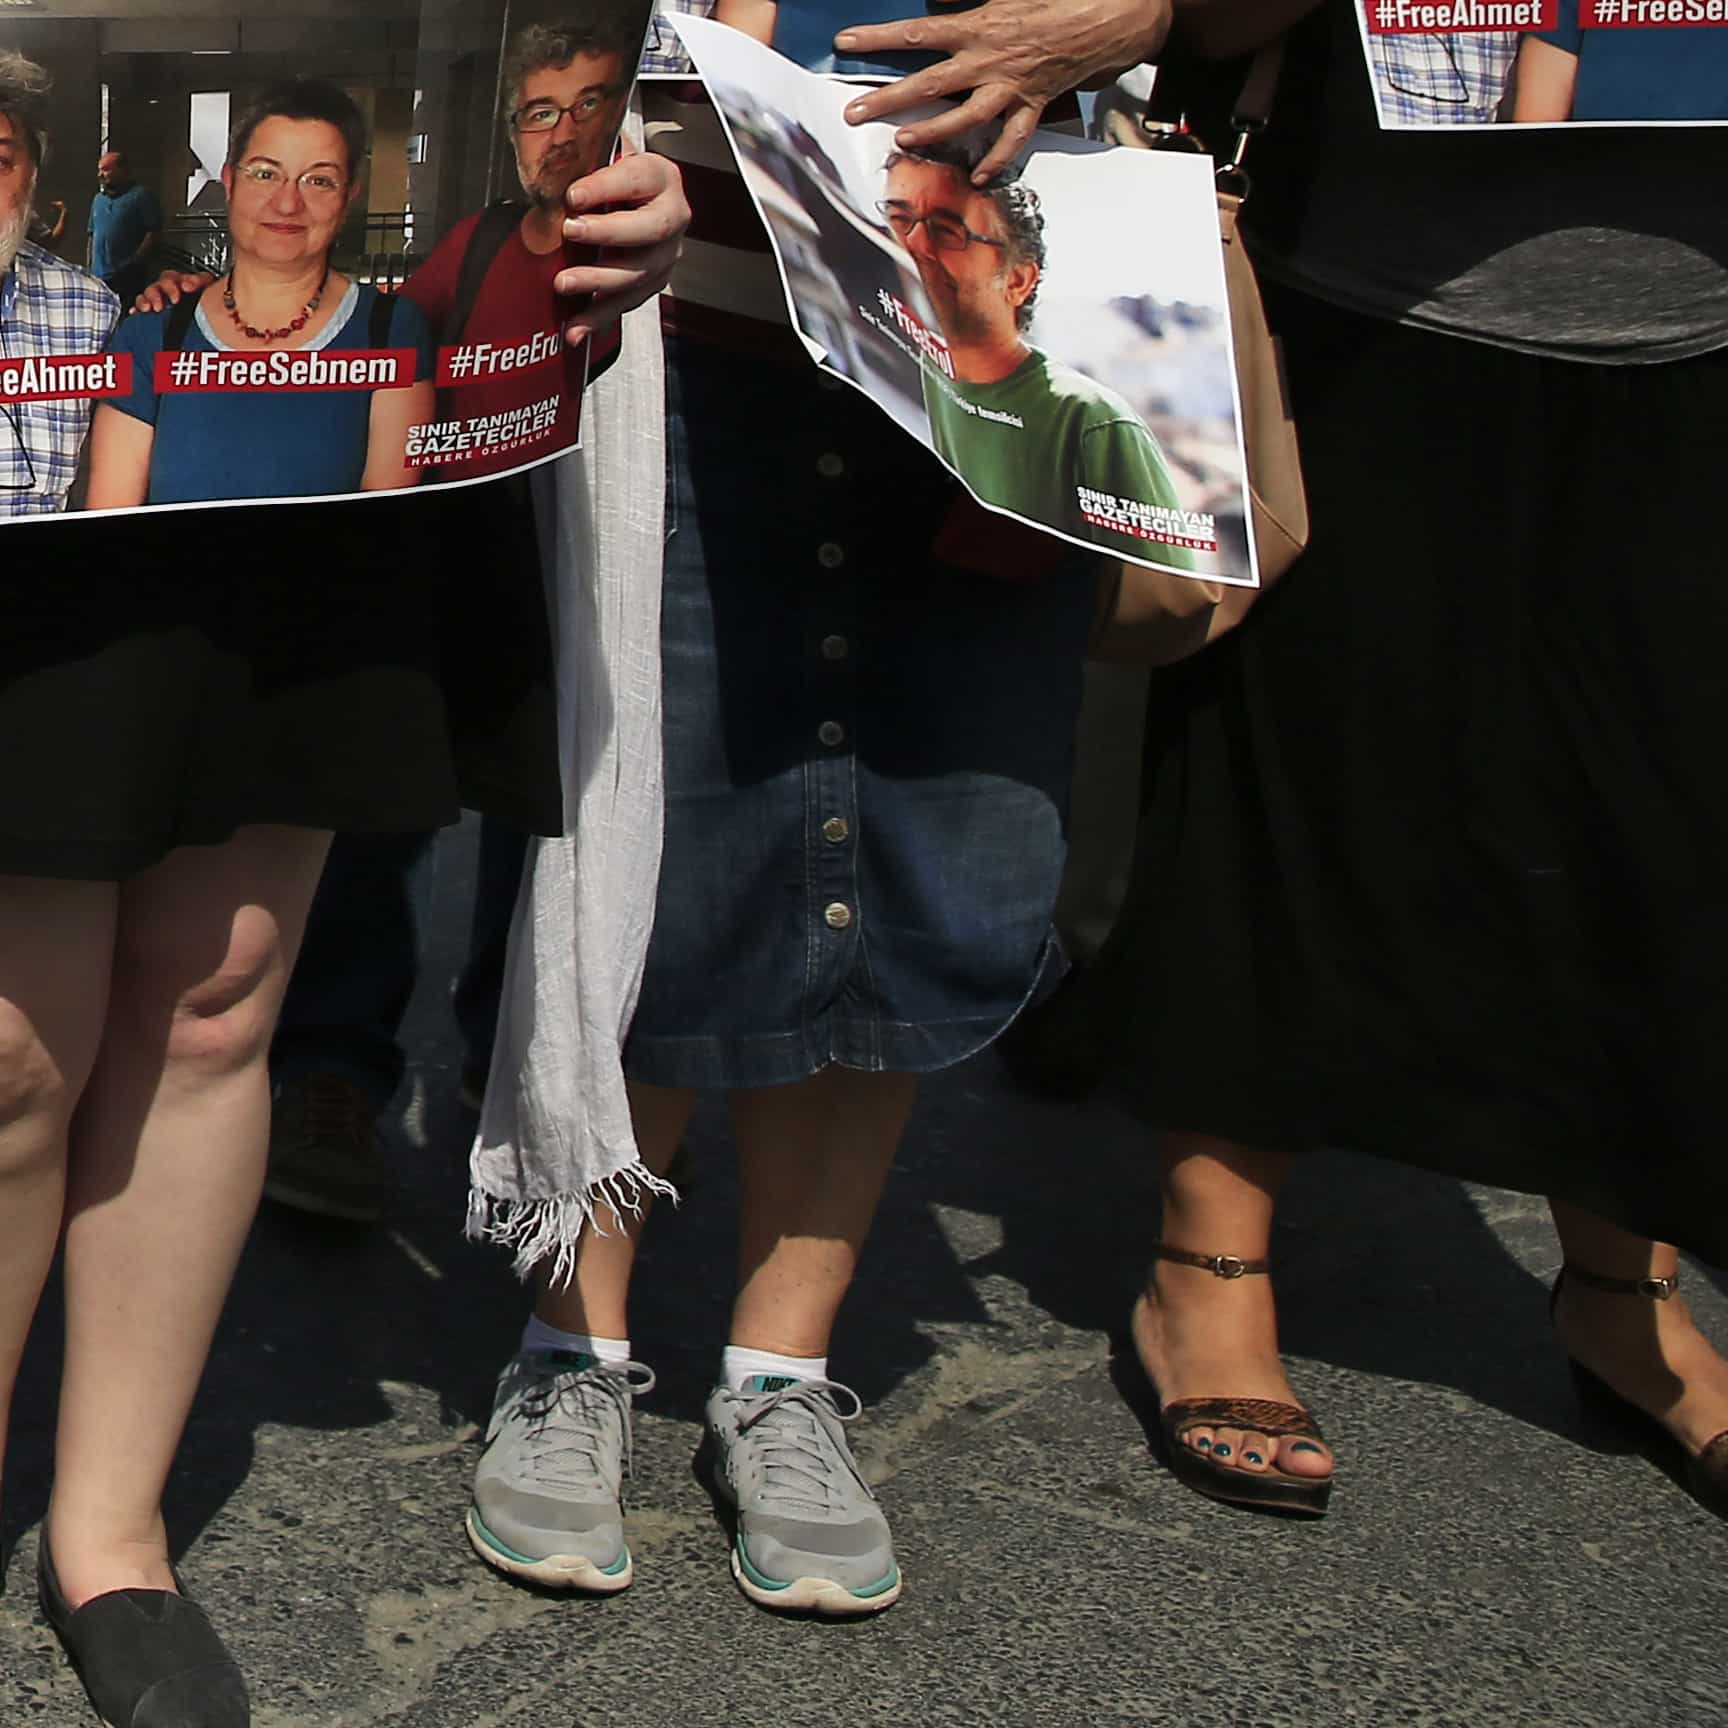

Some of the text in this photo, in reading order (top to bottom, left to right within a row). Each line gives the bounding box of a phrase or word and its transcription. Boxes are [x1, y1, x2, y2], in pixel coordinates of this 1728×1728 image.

[170, 351, 398, 386] #FreeSebnem
[407, 395, 560, 439] SINIR TANIMAYAN
[411, 451, 473, 466] HABERE
[1077, 486, 1215, 526] SINIR TANIMAYAN
